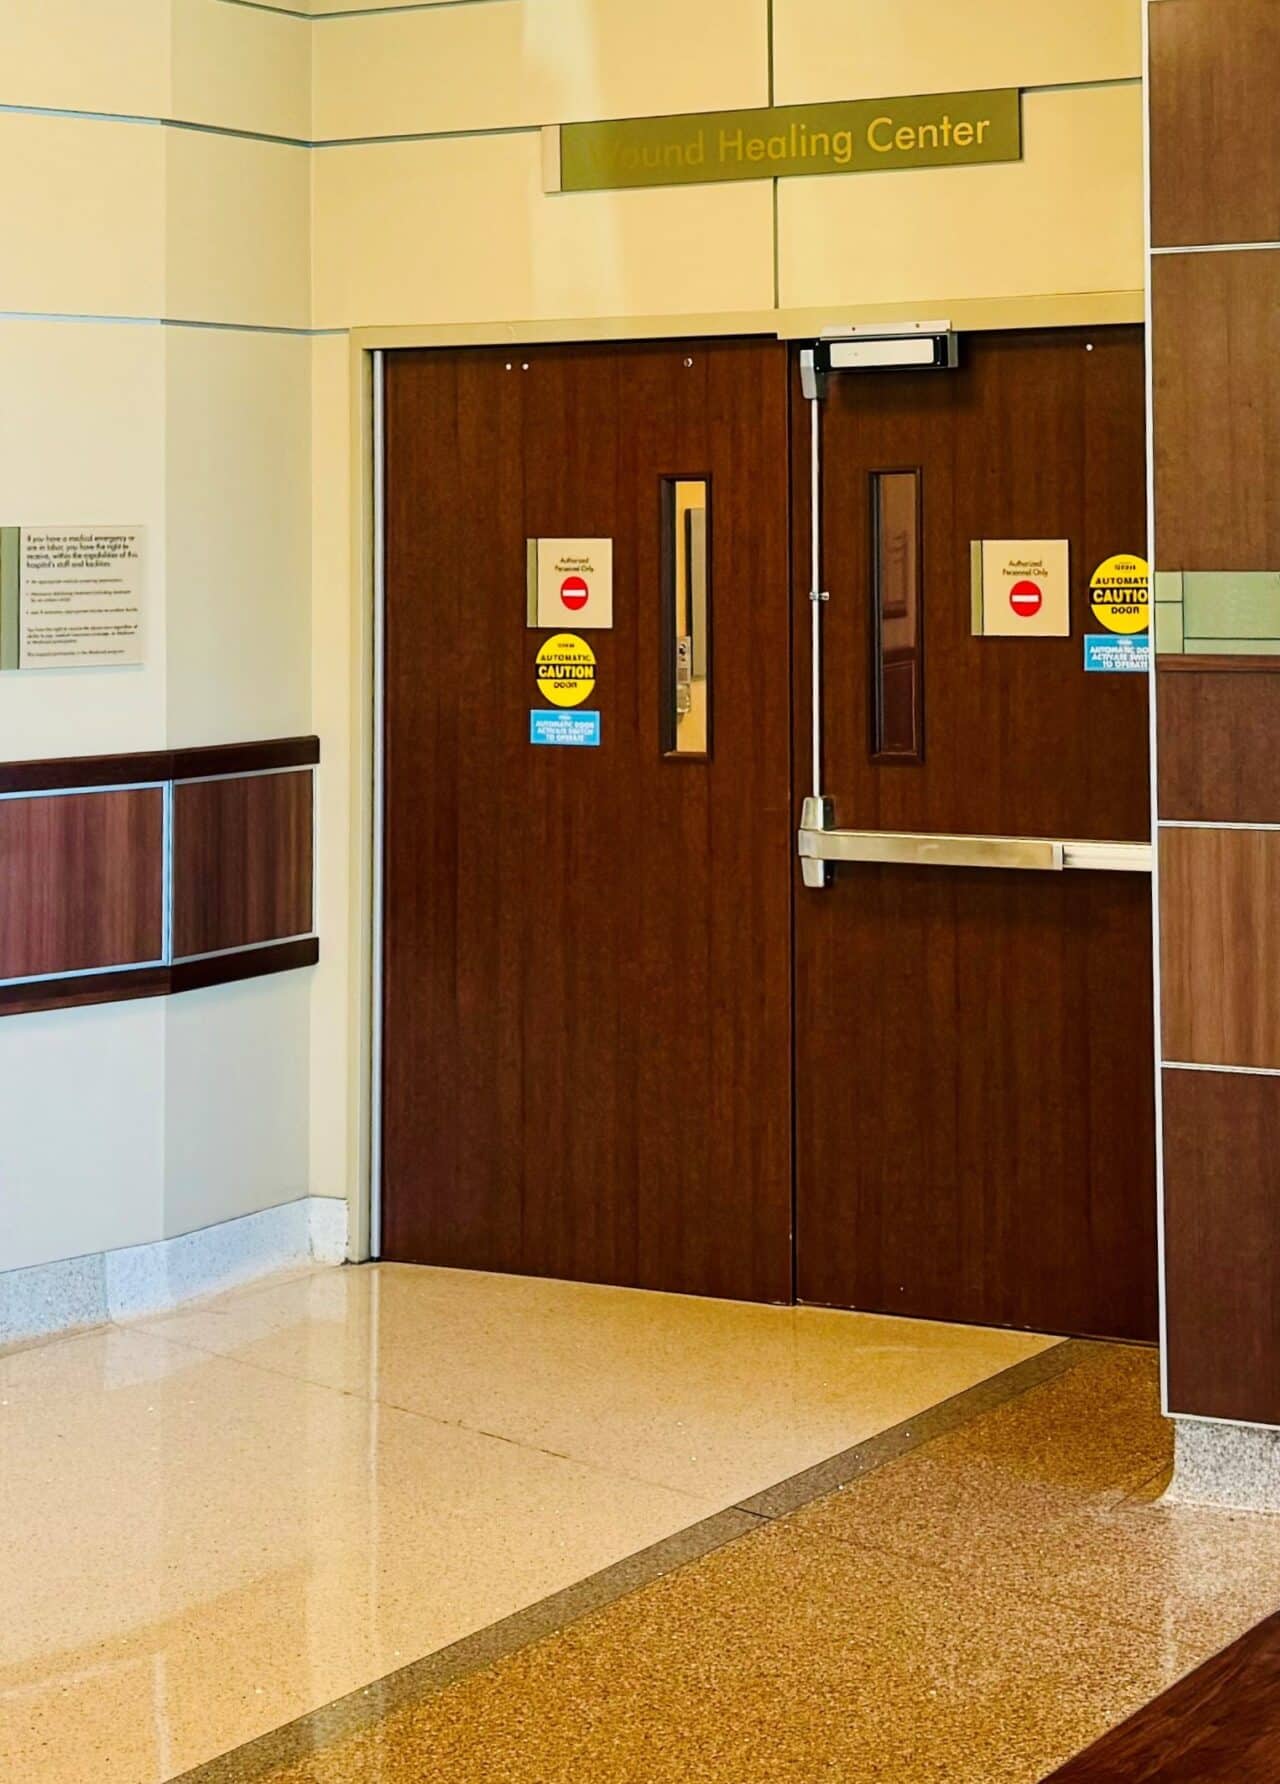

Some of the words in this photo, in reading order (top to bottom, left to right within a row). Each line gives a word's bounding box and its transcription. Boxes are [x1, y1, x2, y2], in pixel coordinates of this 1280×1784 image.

[718, 123, 852, 164] Healing
[867, 115, 991, 152] Center
[1008, 559, 1042, 568] Authorized
[1002, 567, 1032, 576] Personnel
[1033, 567, 1048, 577] Only
[1095, 577, 1148, 585] AUTOMATI
[1092, 589, 1148, 603] CAUTIO
[1111, 606, 1140, 614] DOOR
[540, 654, 591, 662] AUTOMATIC
[1114, 661, 1148, 669] OPERAT
[538, 665, 594, 679] CAUTION
[553, 681, 578, 689] DOOR
